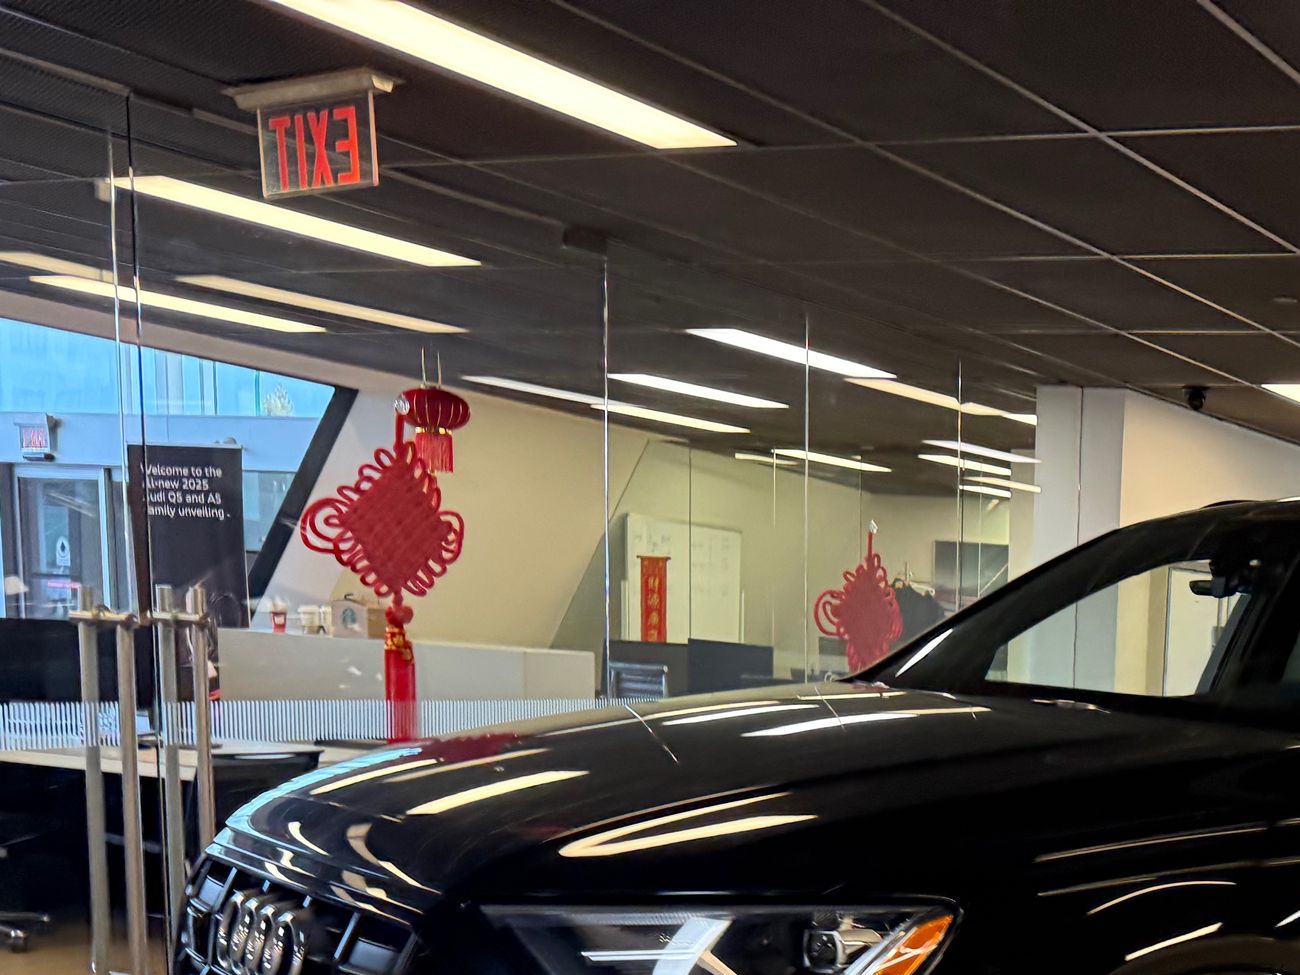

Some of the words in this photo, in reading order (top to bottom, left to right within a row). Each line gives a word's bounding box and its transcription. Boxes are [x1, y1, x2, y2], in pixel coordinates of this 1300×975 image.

[191, 466, 202, 477] to
[205, 466, 222, 478] the
[182, 479, 209, 491] 2025
[142, 491, 165, 503] udi
[168, 491, 183, 504] Q5
[186, 493, 205, 503] and
[207, 492, 222, 504] A5
[145, 505, 176, 518] amily
